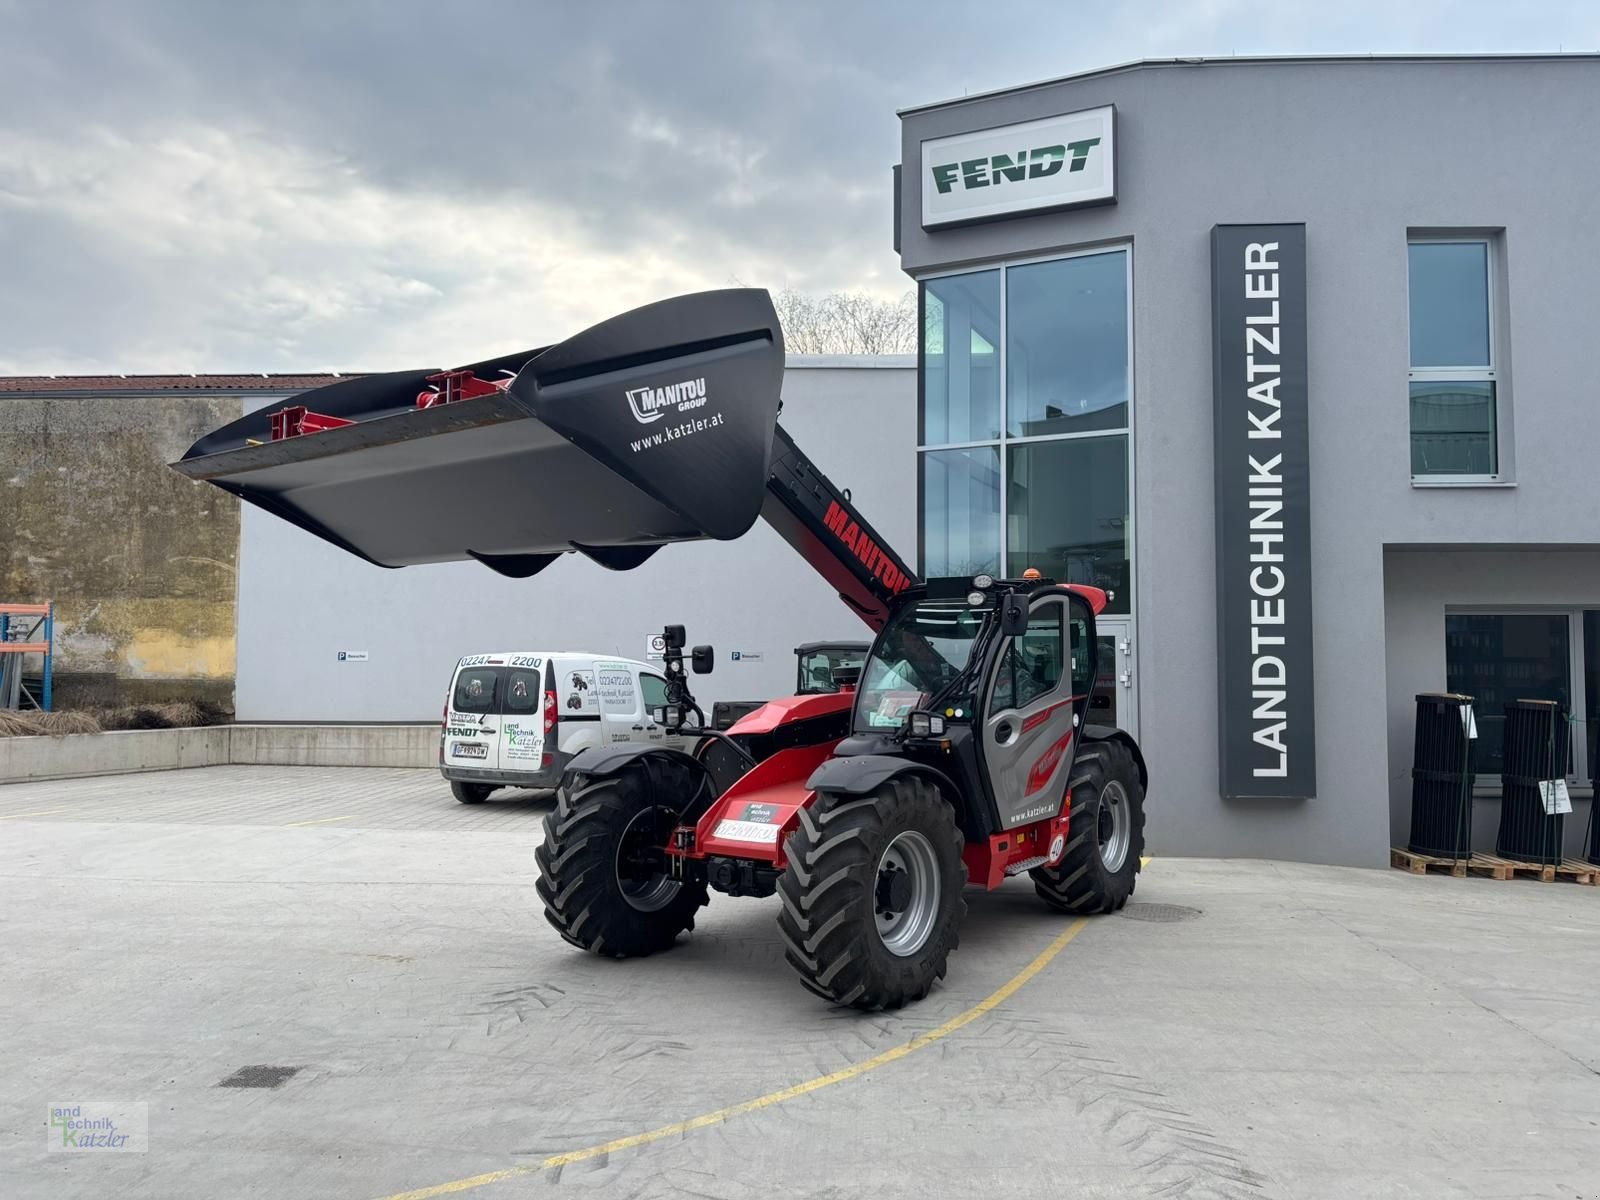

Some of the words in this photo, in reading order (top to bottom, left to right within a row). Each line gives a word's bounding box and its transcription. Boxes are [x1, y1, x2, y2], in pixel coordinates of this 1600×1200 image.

[931, 137, 1102, 194] FENDT
[1244, 241, 1282, 439] KATZLER
[641, 378, 706, 411] MANITOU
[678, 397, 707, 412] GROUP
[630, 412, 724, 452] www.katzler.at
[1248, 452, 1288, 777] LANDTECHNIK
[512, 656, 542, 668] 2200
[447, 727, 479, 737] FENDT
